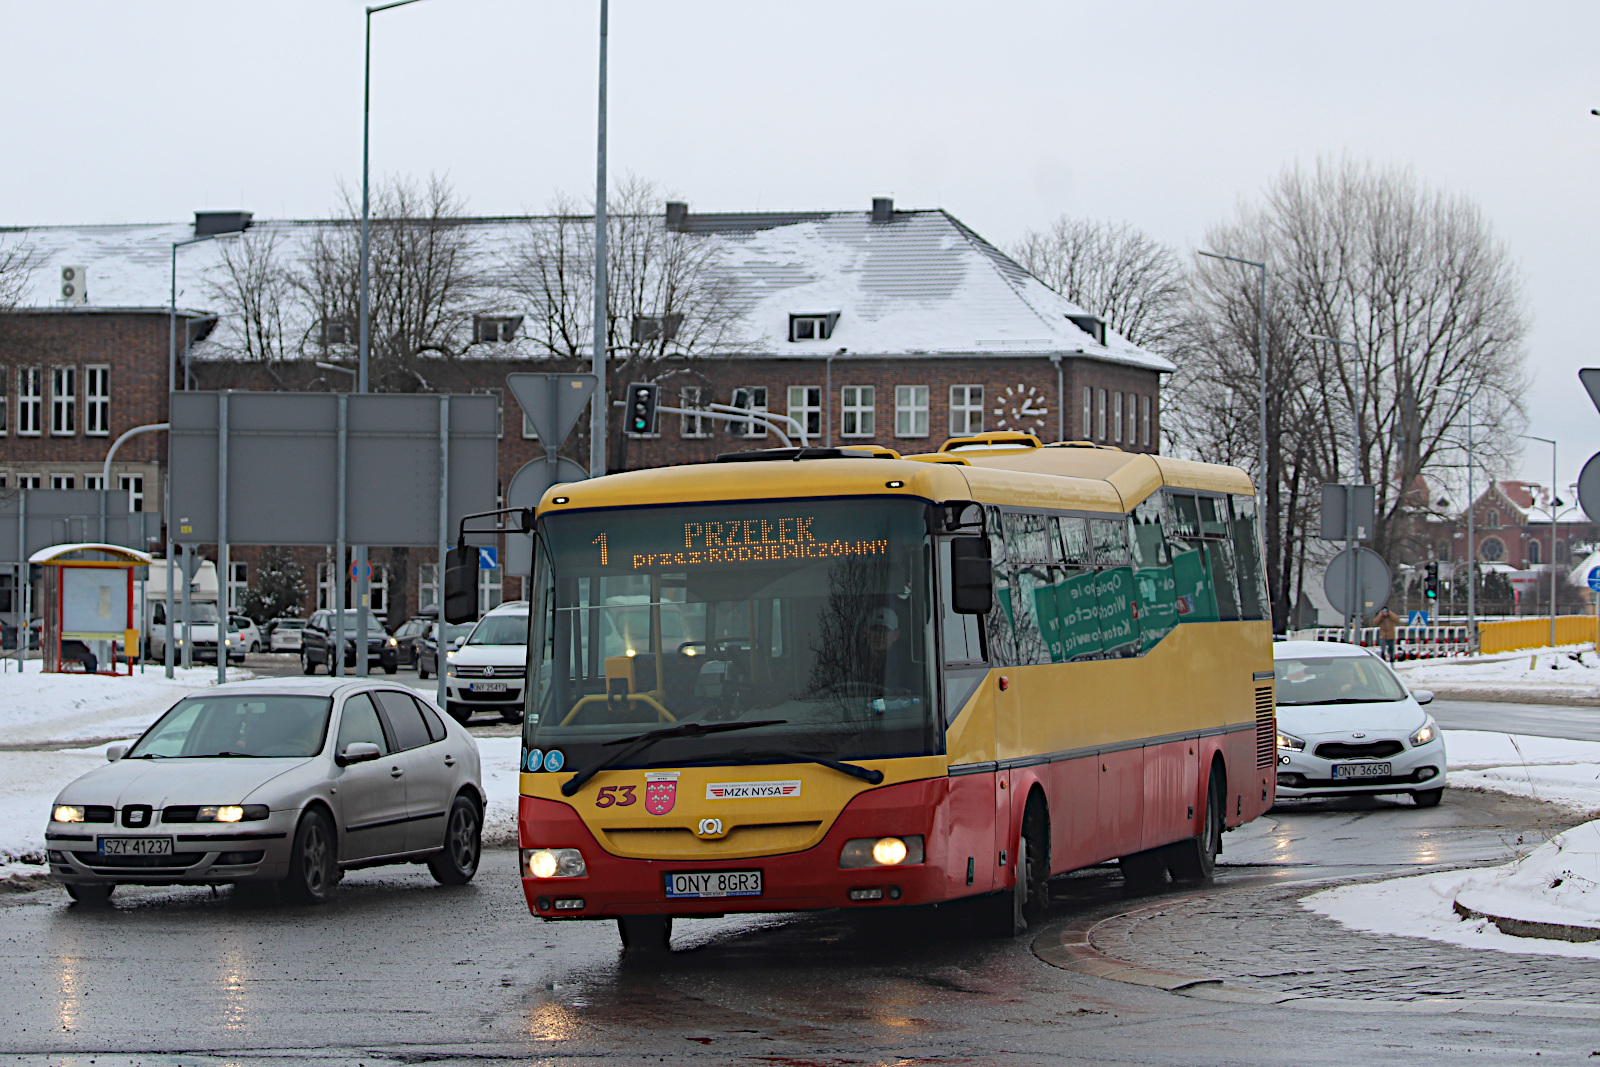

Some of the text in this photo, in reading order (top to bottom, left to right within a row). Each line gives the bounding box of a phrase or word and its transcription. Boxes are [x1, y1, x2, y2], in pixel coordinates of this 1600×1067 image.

[592, 532, 608, 565] 1
[1338, 764, 1390, 777] ONY 36650
[595, 785, 638, 808] 53
[724, 786, 782, 797] MZK NYSA
[105, 840, 171, 854] SZY 41237
[676, 873, 760, 892] ONY 8GR3
